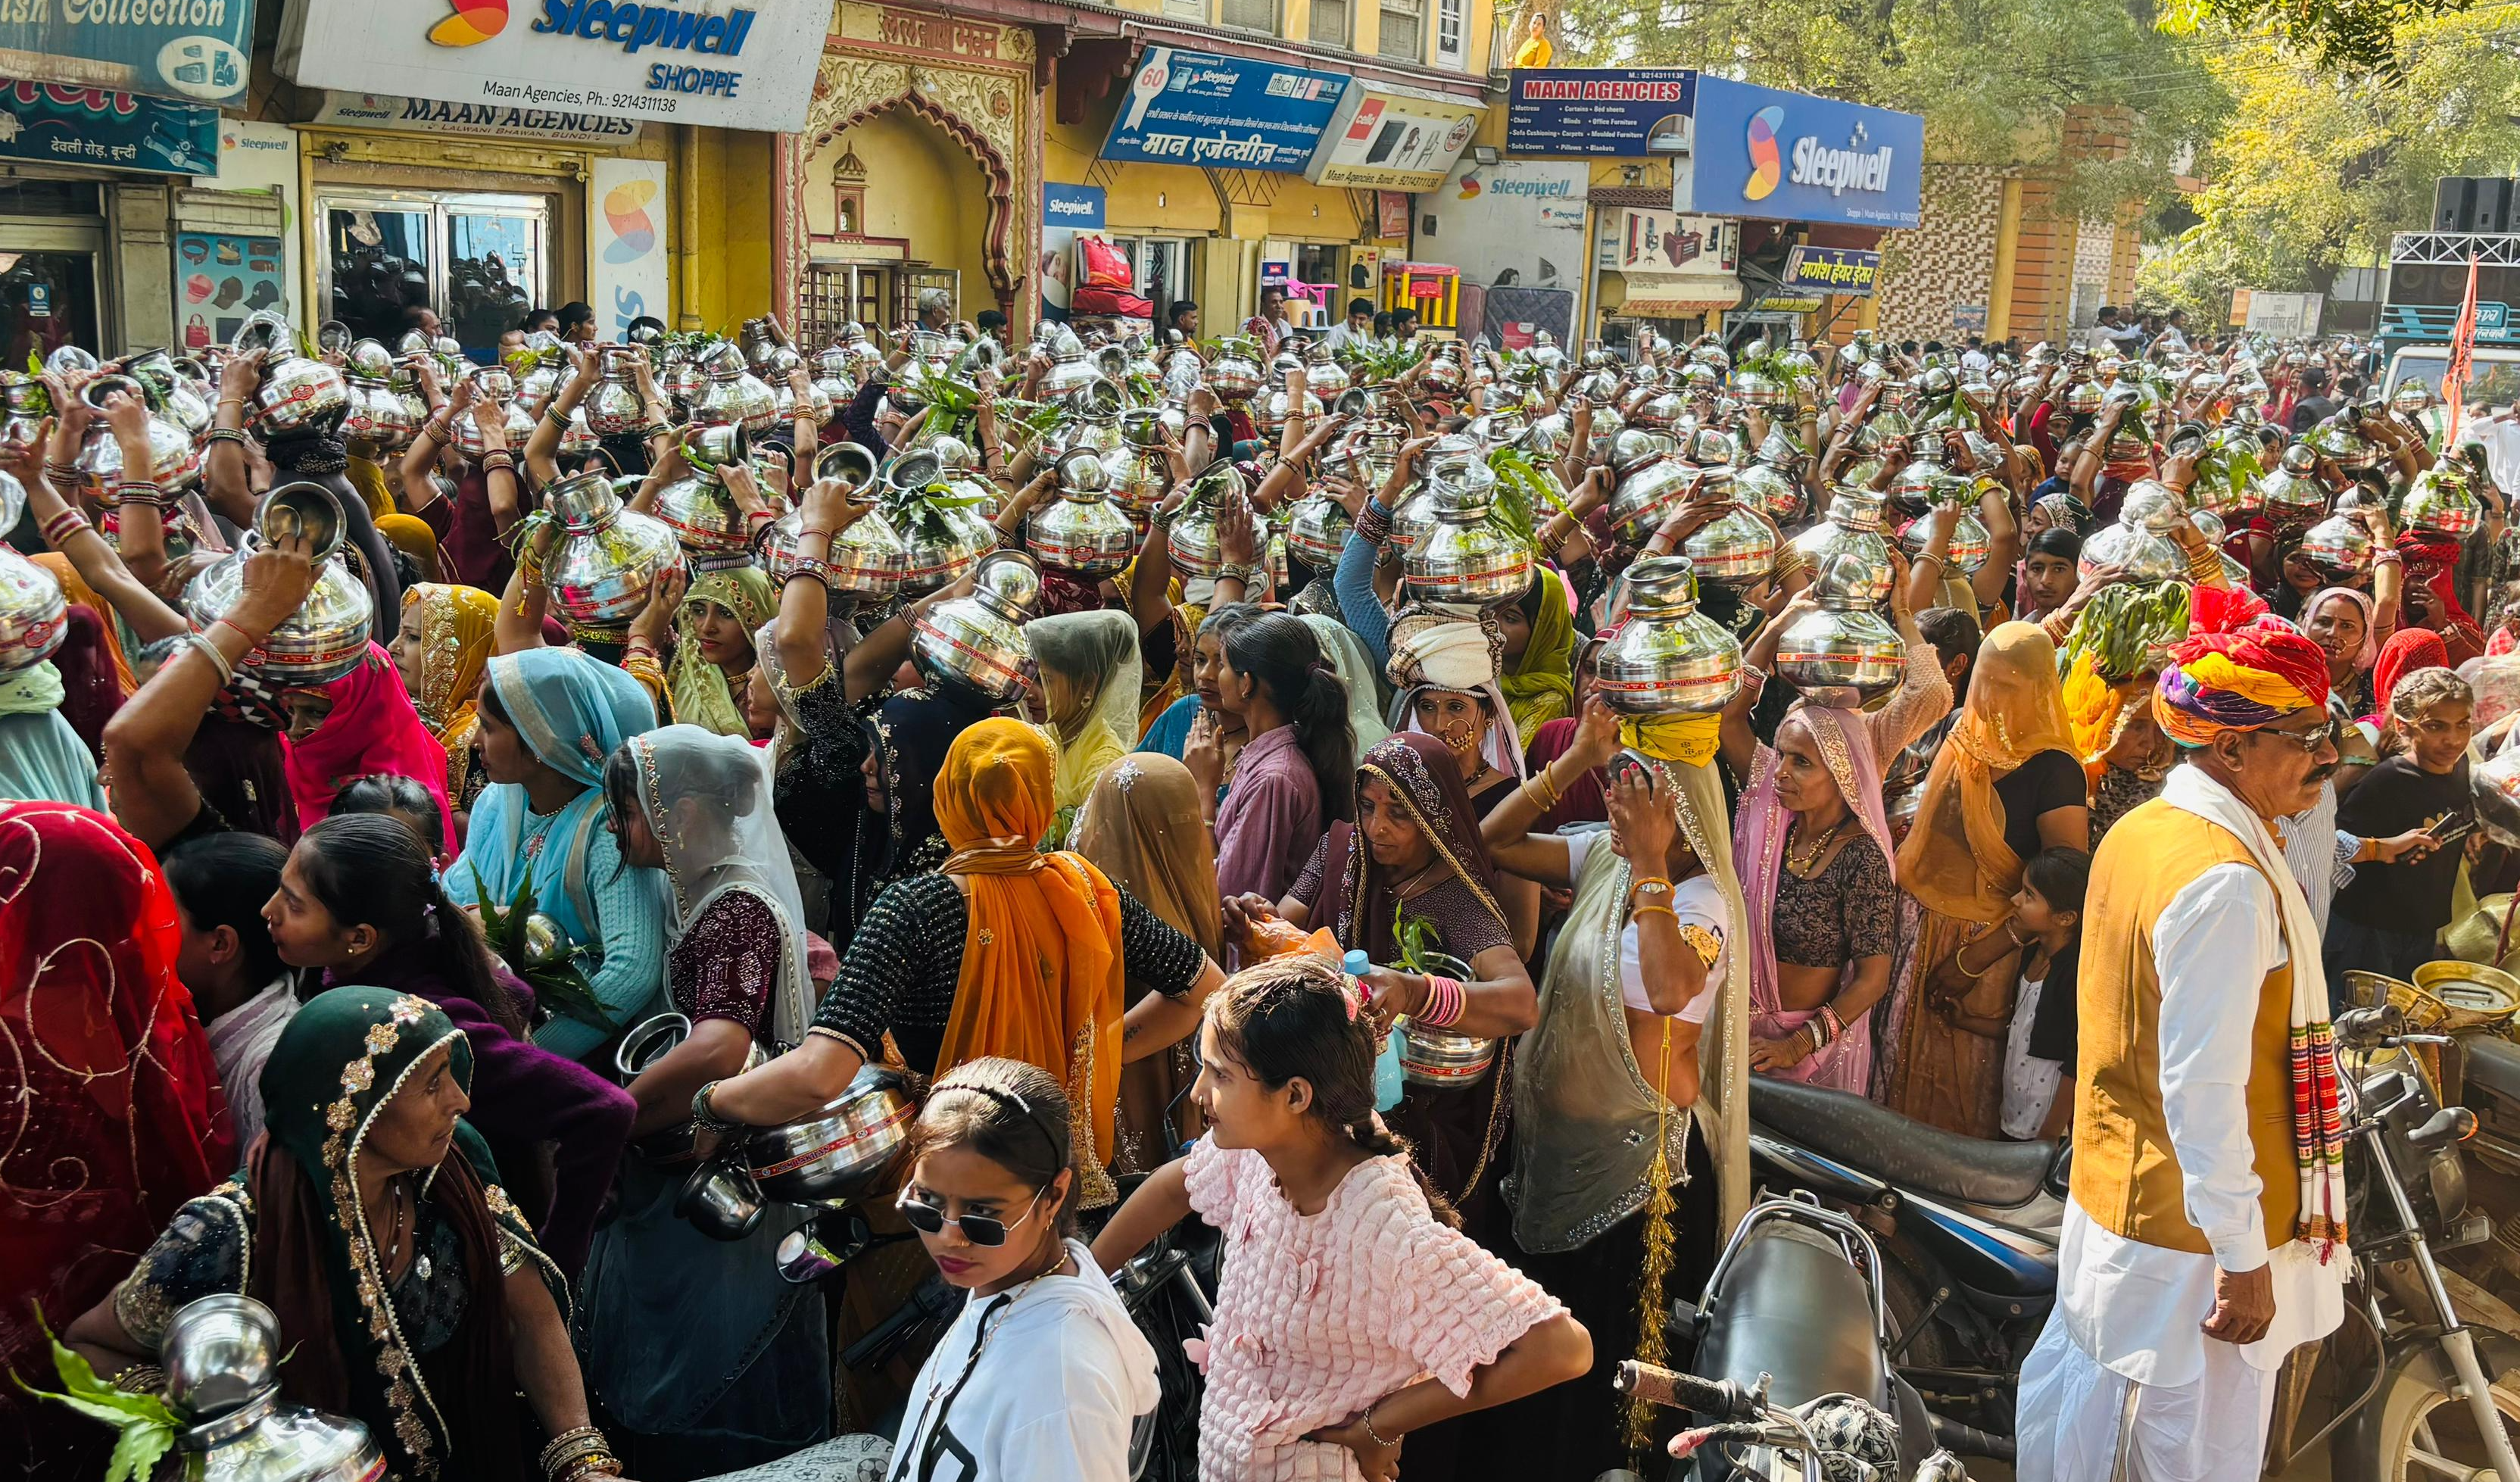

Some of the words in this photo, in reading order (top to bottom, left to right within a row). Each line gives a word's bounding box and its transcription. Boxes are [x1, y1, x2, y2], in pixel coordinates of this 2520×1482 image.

[62, 0, 226, 26] Collection
[531, 0, 757, 56] Sleepwell
[55, 60, 83, 76] Kids
[86, 64, 122, 82] Wear
[645, 62, 743, 98] SHOPPE
[1141, 67, 1165, 88] 60
[1200, 70, 1240, 86] Sleepwell
[483, 80, 521, 98] Maan
[523, 85, 582, 107] Agencies,
[586, 91, 609, 106] Ph.:
[612, 94, 676, 113] 9214311138
[1524, 80, 1581, 100] MAAN
[1582, 81, 1682, 101] AGENCIES
[337, 108, 391, 120] Sleepwell
[400, 98, 498, 125] MAAN
[500, 108, 634, 136] AGENCIES
[1355, 113, 1376, 126] cello
[441, 124, 491, 133] LALWANI
[495, 127, 545, 137] BHAWAN,
[551, 132, 591, 140] BUNDI
[51, 136, 82, 154] देवली
[111, 142, 137, 161] बून्दी
[241, 138, 288, 151] Sleepwell
[1142, 133, 1193, 157] मान
[1193, 129, 1278, 165] एजेन्सीज़
[1790, 136, 1892, 196] Sleepwell
[1325, 170, 1346, 182] Maan
[1376, 174, 1396, 185] Bundi
[1398, 176, 1439, 188] 9214311138
[1490, 179, 1571, 197] Sleepwell
[1049, 199, 1092, 216] Sleepwell
[1800, 254, 1832, 280] गणेश
[1830, 257, 1854, 284] हैयर
